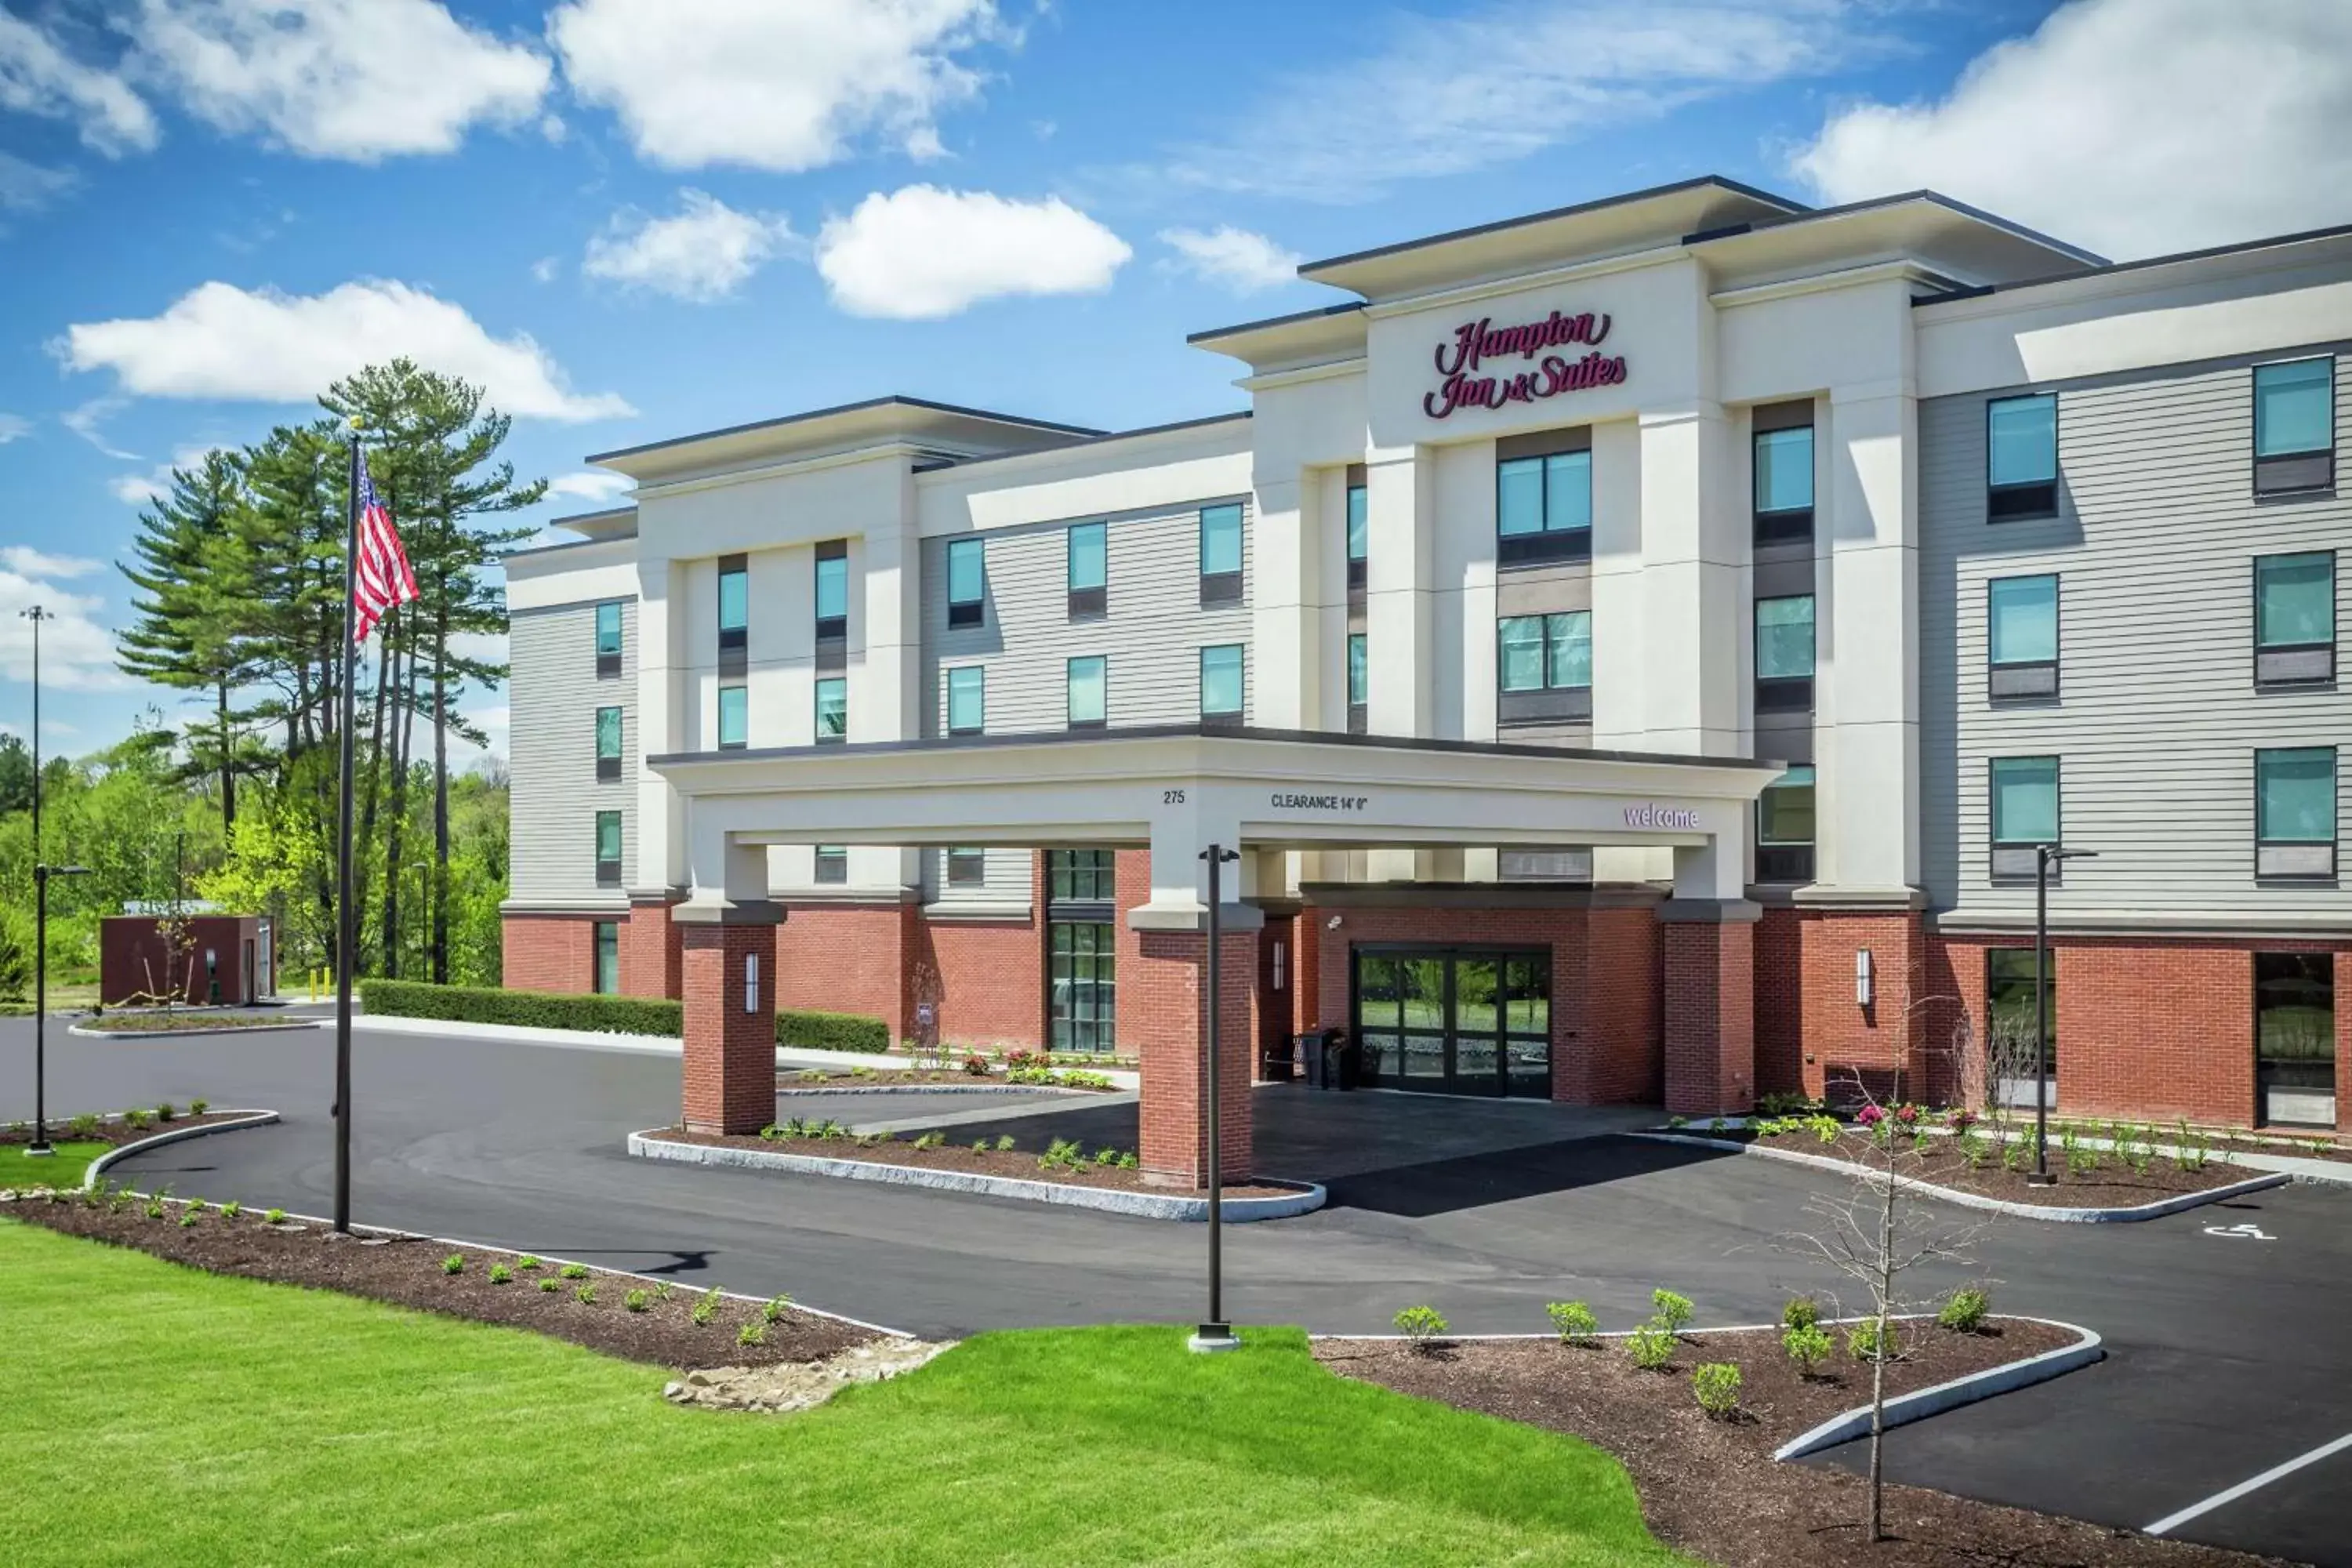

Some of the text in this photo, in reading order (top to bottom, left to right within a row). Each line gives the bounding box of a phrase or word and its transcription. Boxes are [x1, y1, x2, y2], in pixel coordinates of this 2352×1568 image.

[1435, 310, 1611, 376] Hampton
[1424, 351, 1628, 419] Inn & Suites
[1163, 790, 1185, 804] 275
[1272, 794, 1338, 809] CLEARANCE
[1624, 803, 1699, 828] welcome
